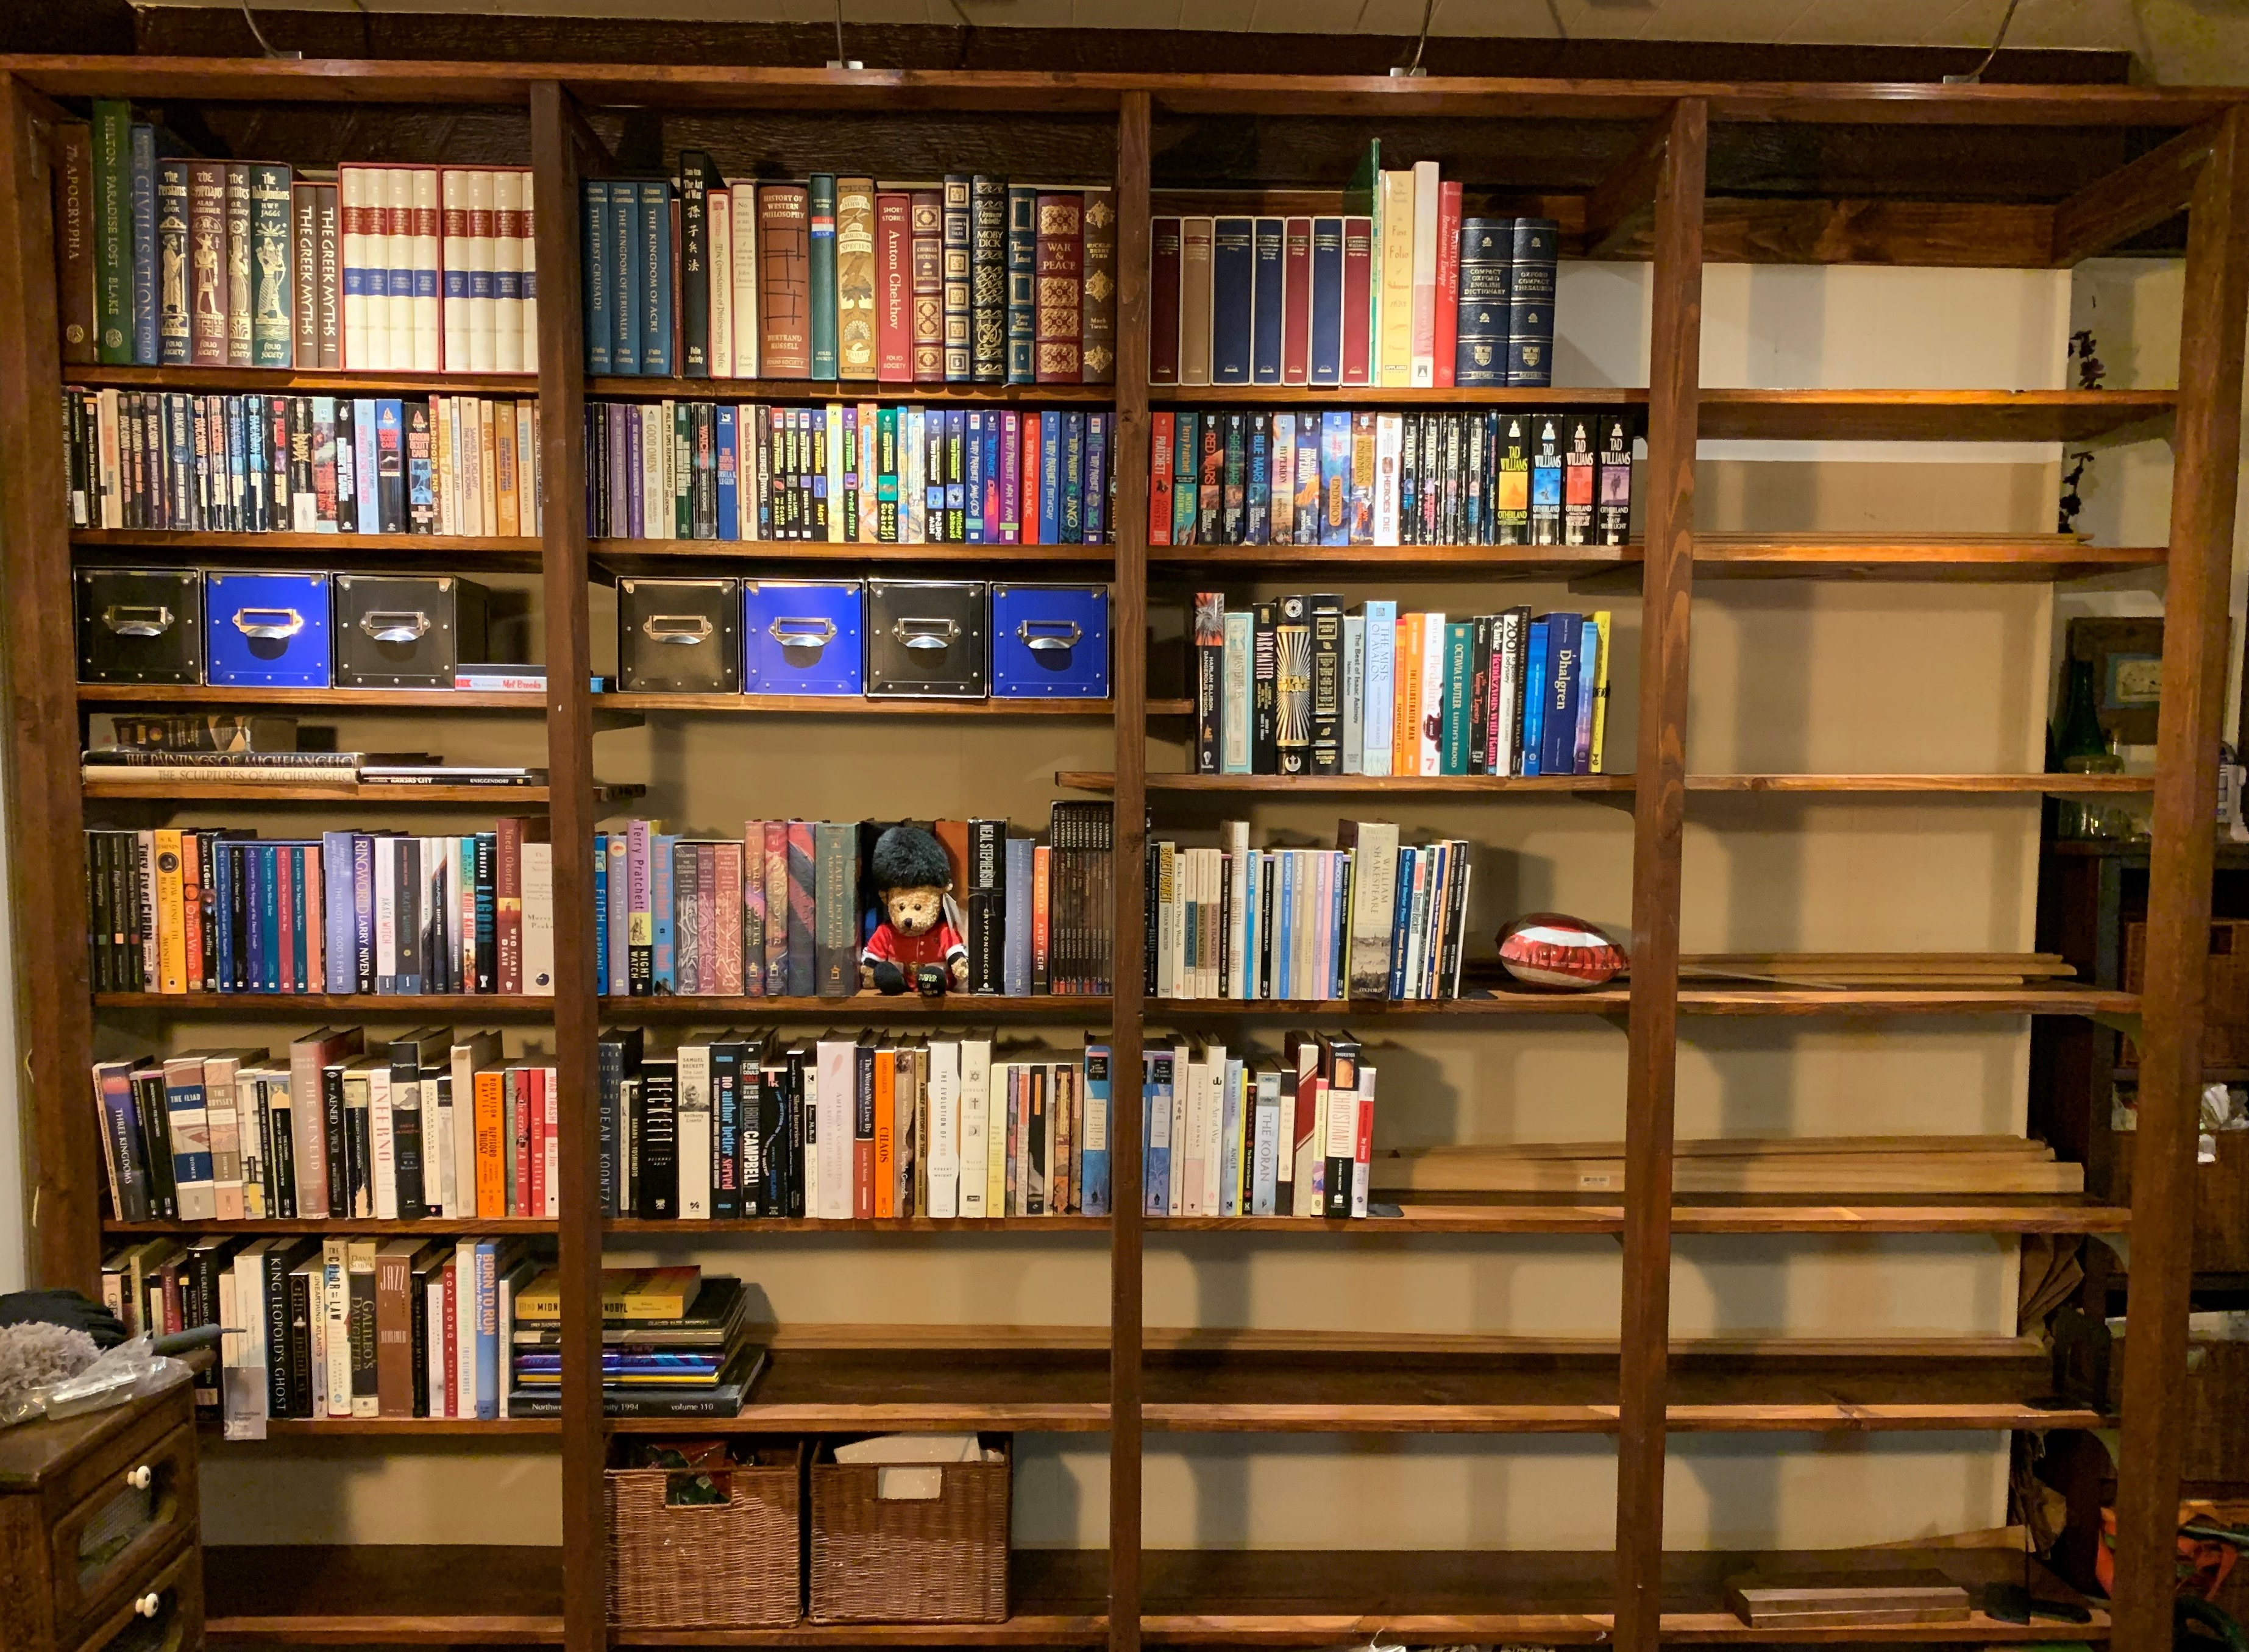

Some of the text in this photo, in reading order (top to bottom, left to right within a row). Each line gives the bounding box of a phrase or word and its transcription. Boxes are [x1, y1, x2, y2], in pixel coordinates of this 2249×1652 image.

[67, 169, 79, 260] APOCRYPHA
[105, 116, 118, 315] MILTON PARADISE LOST BLAKE
[300, 205, 313, 235] THE
[321, 207, 335, 237] THE
[978, 231, 1003, 239] MOBY
[135, 174, 152, 321] CIVILISATION
[300, 238, 313, 281] GREEK
[321, 239, 335, 283] GREEK
[979, 239, 1000, 247] DICK
[1043, 261, 1076, 270] PEACE
[650, 290, 658, 304] OF
[889, 230, 901, 329] Anton Chekhov
[300, 284, 313, 335] MYTHS
[322, 285, 335, 336] MYTHS
[647, 425, 657, 473] GOOD OMENS
[1253, 436, 1265, 483] BLUE MARS
[1501, 458, 1527, 470] WILLIAMS
[1508, 446, 1520, 458] TAD
[1601, 452, 1630, 464] WILLIAMS
[1610, 438, 1622, 450] TAD
[1067, 497, 1078, 527] JINGO
[1371, 640, 1379, 681] AVALON
[1380, 626, 1389, 681] THE MISTS
[1507, 620, 1516, 655] 2001
[502, 679, 541, 689] Mel Brooks
[1554, 649, 1572, 710] Dhalgren
[126, 752, 355, 767] THE PAINTINGS OF MICHELANGELO
[158, 770, 352, 781] THE SCULPTURES OF MICHELANGELO
[980, 824, 993, 842] NEAL
[505, 854, 515, 895] Okorafor
[634, 826, 644, 910] Terry Pratchett
[980, 843, 993, 888] STEPHENSON
[1371, 846, 1381, 914] SHAKESPEARE
[1380, 857, 1390, 904] WILLIAM
[355, 840, 369, 975] RINGWORLD LARRY NIVEN
[1412, 892, 1423, 934] Samuel Beckett
[640, 952, 648, 979] NIGHT
[116, 1109, 132, 1184] THREE KINGDOMS
[305, 1080, 319, 1171] THE AENEID
[374, 1085, 391, 1162] INFERNO
[722, 1077, 737, 1189] no author better served
[1332, 1092, 1351, 1157] CHRISTIANITY
[600, 1107, 611, 1201] DEAN KOONTZ
[744, 1131, 759, 1185] CAMPBELL
[1260, 1113, 1271, 1182] THE KORAN
[329, 1257, 341, 1320] COLOR LAW
[381, 1266, 404, 1291] JAZZ
[483, 1253, 495, 1336] BORN TO RUN
[271, 1258, 286, 1411] KING LEOPOLD'S GHOST
[351, 1296, 362, 1372] DAUGHTER
[363, 1300, 374, 1369] GALILEO'S
